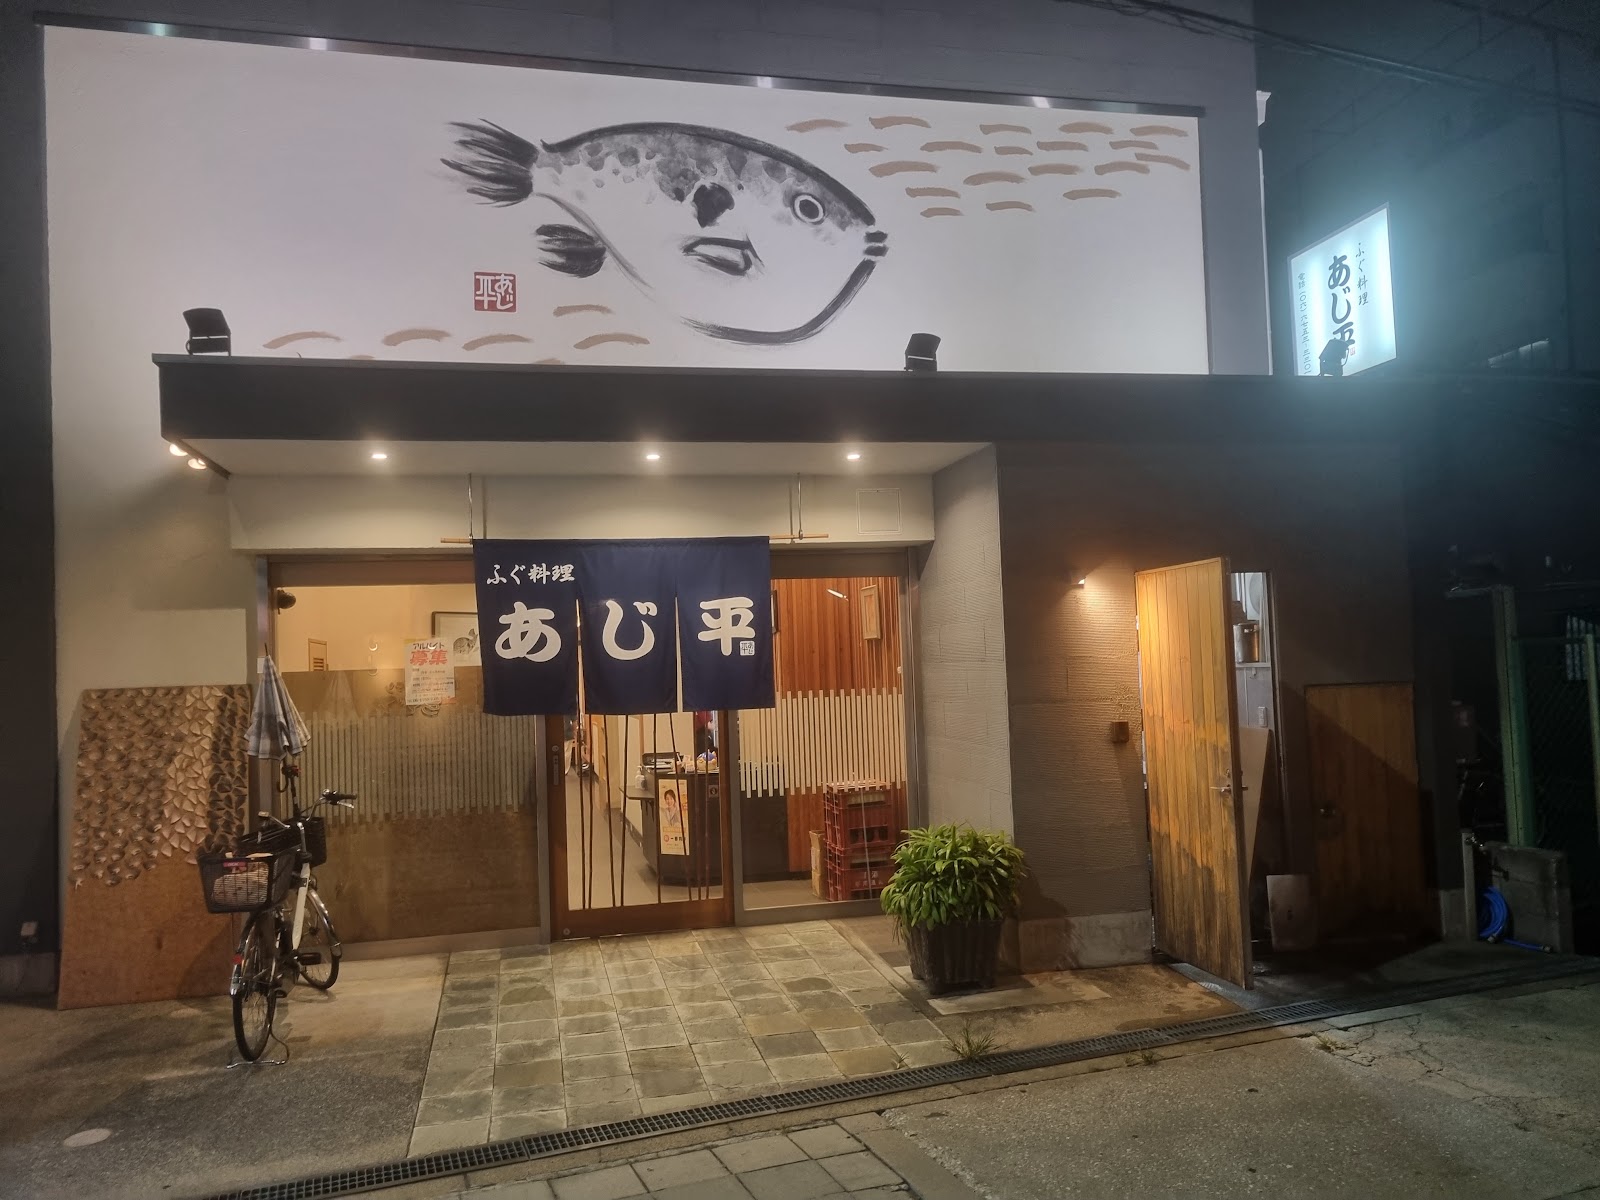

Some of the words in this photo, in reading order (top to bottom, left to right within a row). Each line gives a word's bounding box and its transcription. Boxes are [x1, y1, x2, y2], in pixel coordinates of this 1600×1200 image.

[1355, 242, 1369, 306] ふぐ料理
[486, 563, 575, 585] ふぐ料理
[409, 649, 448, 666] 募集
